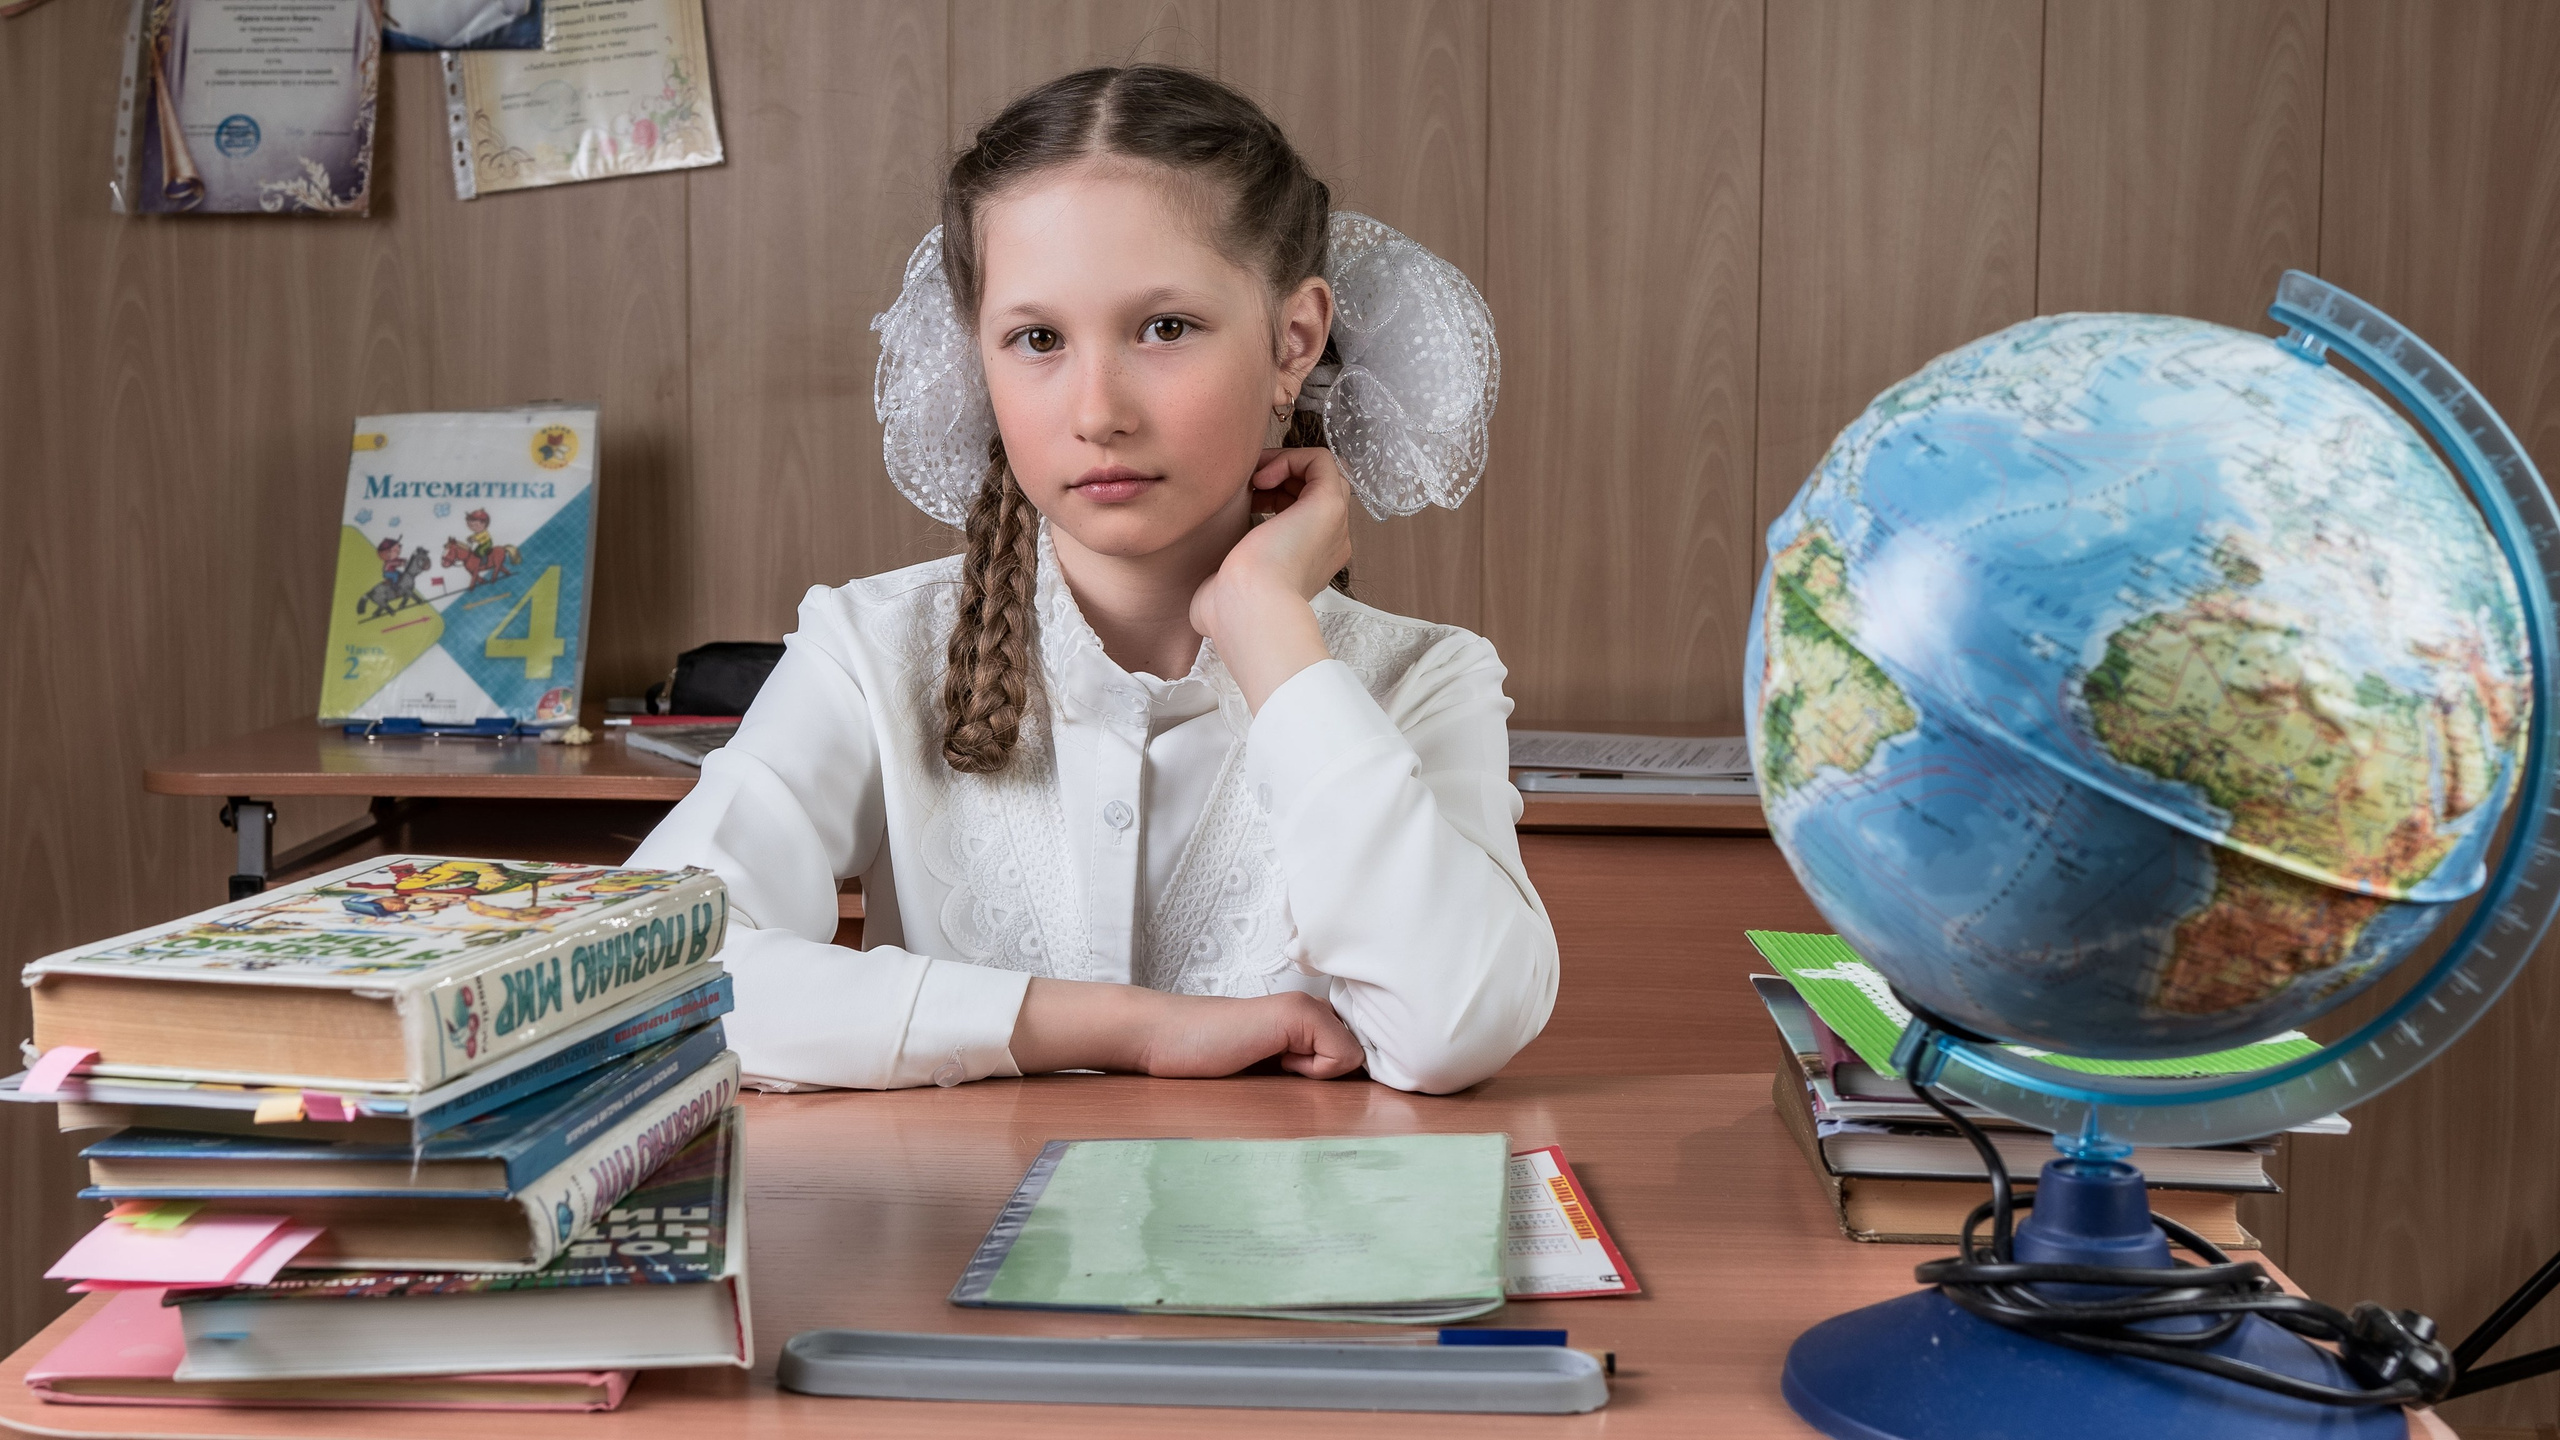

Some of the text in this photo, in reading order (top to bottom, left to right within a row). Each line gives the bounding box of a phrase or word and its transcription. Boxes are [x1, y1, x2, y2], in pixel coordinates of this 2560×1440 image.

[363, 474, 556, 499] Математика
[485, 565, 565, 679] 4
[345, 643, 385, 656] Часть
[343, 657, 360, 679] 2
[495, 902, 712, 1037] Я ПОЗНАЮ МИР
[614, 1011, 668, 1043] РАЗРАБОТКИ
